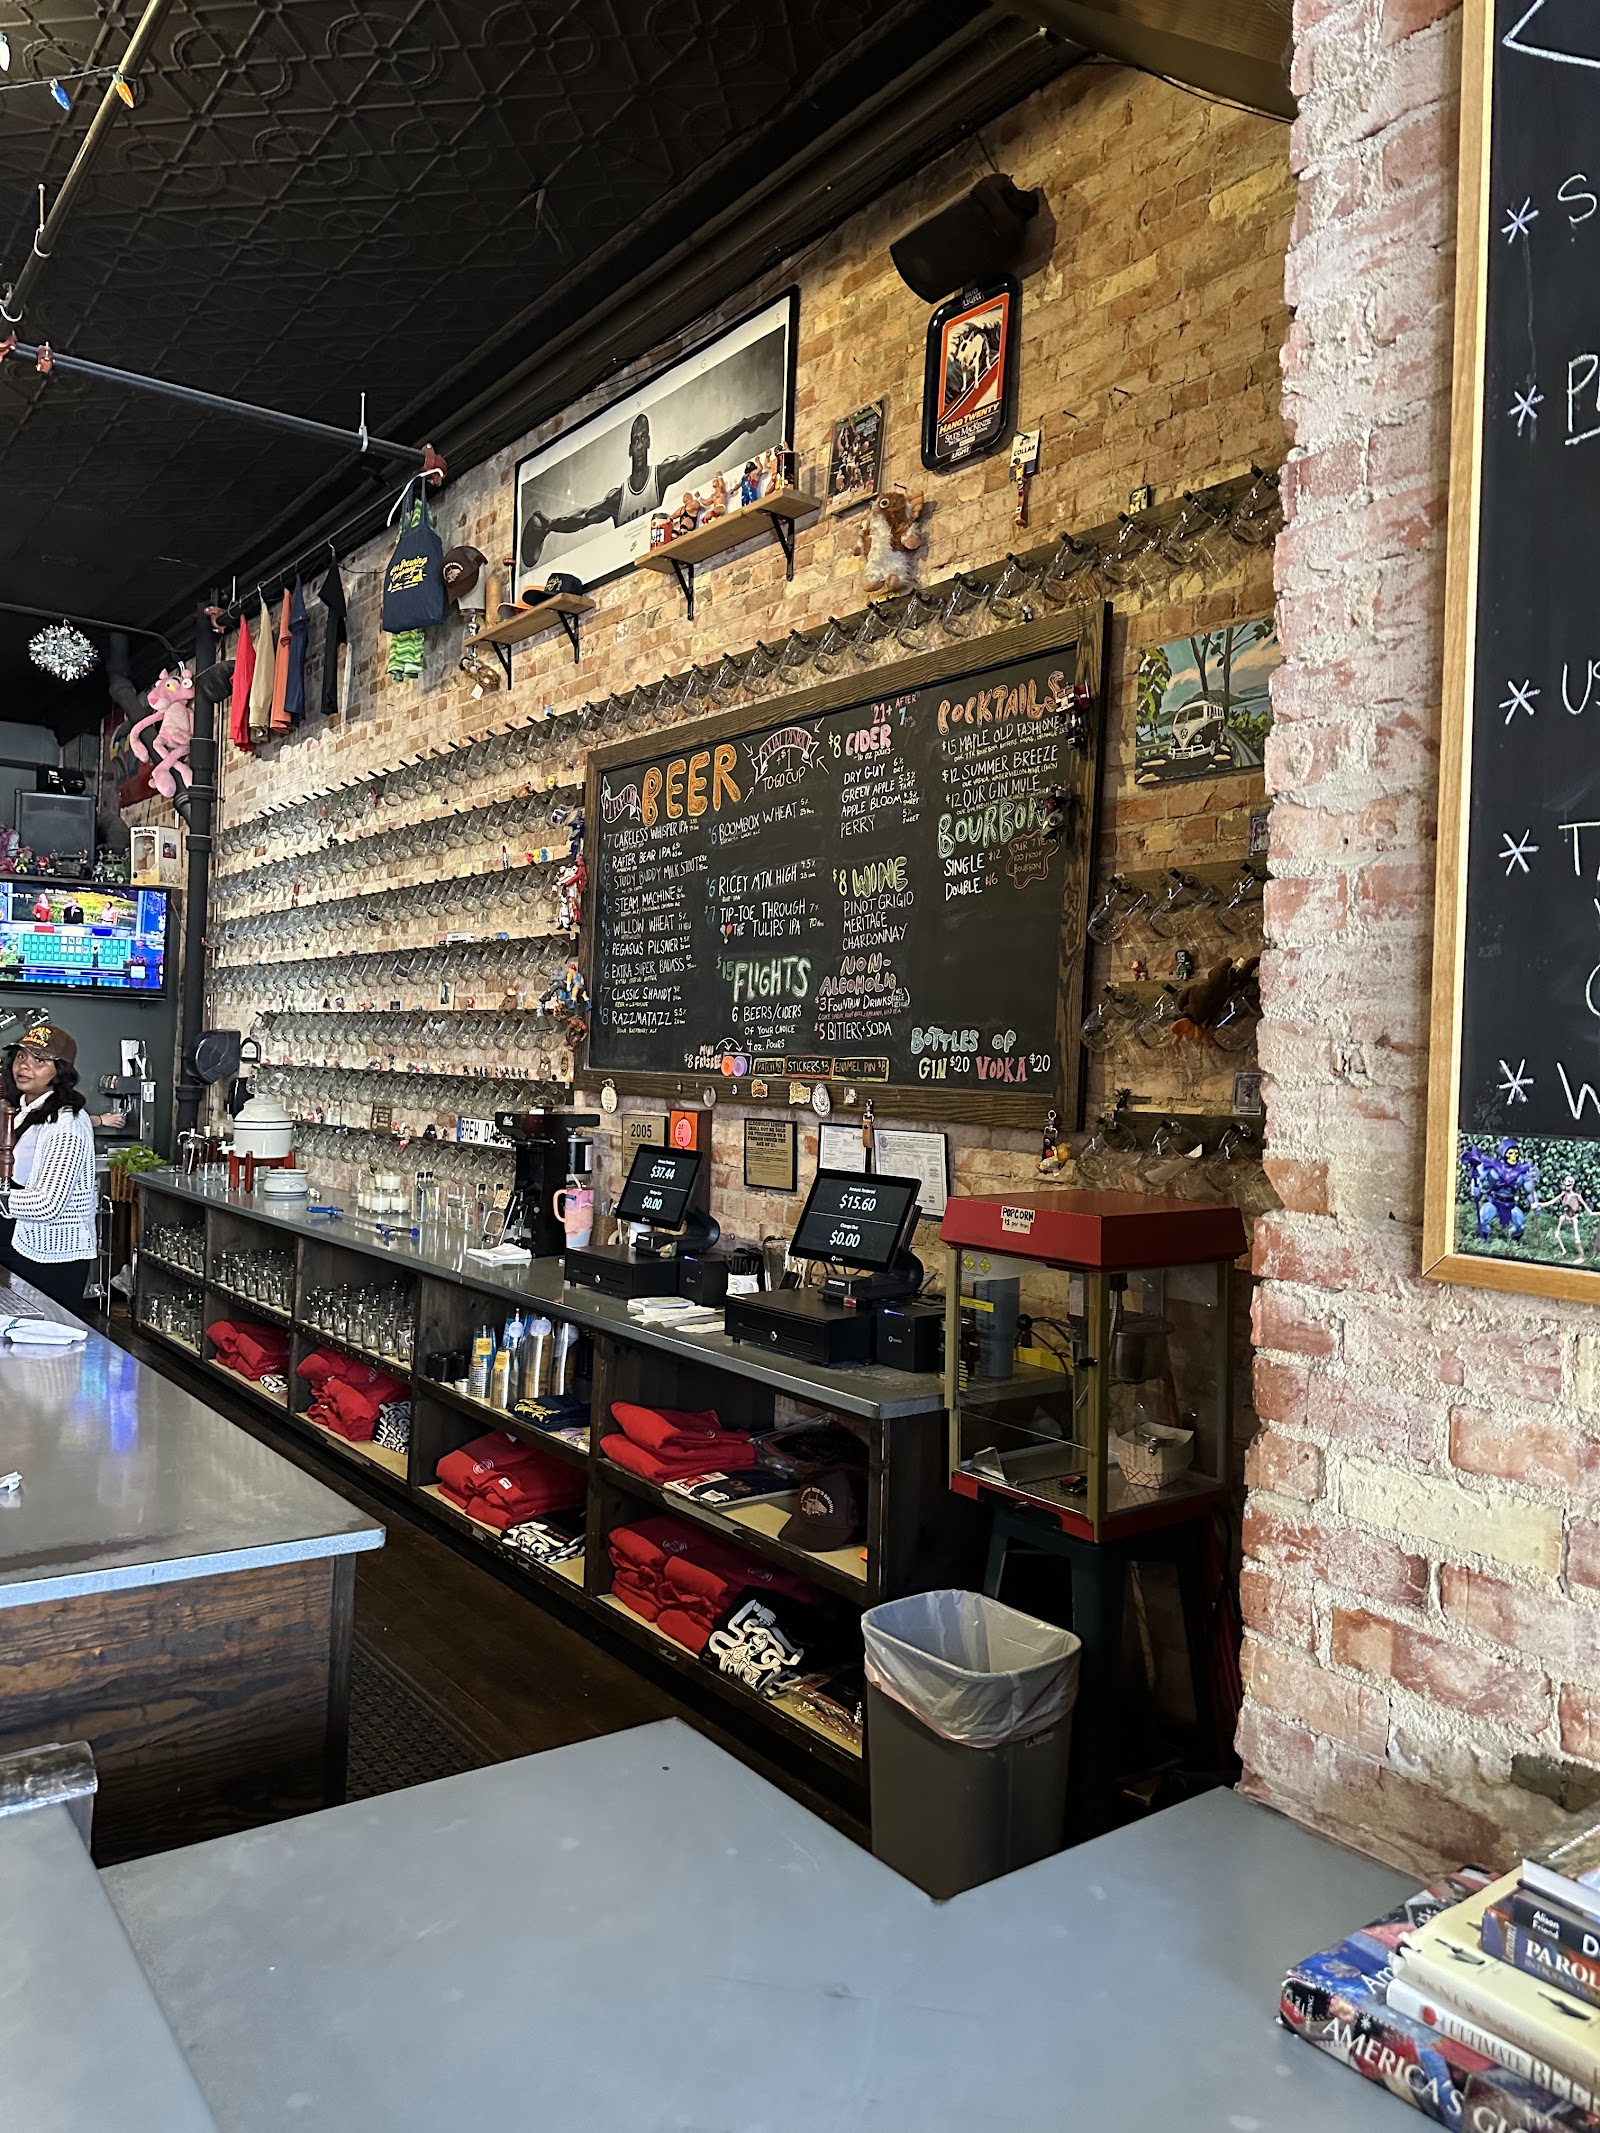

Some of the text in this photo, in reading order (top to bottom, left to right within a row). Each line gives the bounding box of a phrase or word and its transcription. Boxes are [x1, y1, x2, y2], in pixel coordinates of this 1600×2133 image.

[963, 292, 982, 307] LIGHT
[939, 402, 1000, 434] HANG TWENTY
[952, 446, 971, 458] LIGHT
[1013, 445, 1036, 457] COLLAR
[895, 695, 917, 708] AFTER
[937, 671, 1065, 735] COCKTAILS
[828, 731, 841, 758] $8
[846, 724, 892, 756] CIDER
[959, 724, 1013, 754] MAPLE OLD
[786, 766, 806, 784] CUP
[844, 763, 886, 785] DRY GUY
[942, 745, 1058, 784] $12 SUMMER BREEZE
[641, 744, 741, 826] BEER
[841, 771, 916, 803] GREEN APPLE 5.5%
[899, 780, 915, 790] TART
[946, 794, 962, 808] $12
[963, 785, 986, 808] OUR
[989, 781, 1008, 799] GIN
[1011, 774, 1040, 794] MULE
[841, 795, 902, 817] APPLE BLOOM
[708, 824, 718, 844] $6
[718, 813, 760, 842] BOOMBOX
[762, 802, 798, 824] WHEAT
[800, 798, 809, 806] 5%
[841, 814, 875, 838] PERRY
[937, 797, 1048, 858] BOURBON
[603, 832, 611, 849] $7
[614, 826, 649, 849] CARELESS
[650, 821, 678, 841] WHISPER
[679, 820, 689, 834] IPA
[612, 852, 636, 870] RAFTER
[639, 849, 656, 864] BEAR
[658, 846, 671, 860] IPA
[1013, 841, 1028, 853] OUR
[1025, 850, 1042, 861] PROOF
[614, 873, 636, 890] STUDY
[639, 867, 662, 885] BUDDY
[663, 863, 680, 879] MILK
[680, 856, 699, 876] STOUT
[944, 850, 1001, 877] SINGLE $12
[1013, 862, 1042, 874] BOURBON
[706, 864, 798, 898] $6 RICEY HIGH
[833, 856, 908, 897] $8 WINE
[945, 872, 998, 901] DOUBLE $16
[615, 895, 639, 913] STEAM
[642, 886, 676, 907] MACHINE
[704, 898, 819, 923] $7 TIP-TOE THROUGH 7%
[844, 890, 914, 917] PINOT GRIGIO
[613, 912, 687, 937] WILLOW WHEAT 5%
[733, 918, 801, 938] THE TULIPS IPA
[843, 911, 888, 934] MERITAGE
[601, 938, 679, 957] $6 PEGASUS PILSNER
[842, 922, 908, 951] CHARDONNAY
[601, 961, 610, 979] $6
[611, 962, 633, 978] EXTRA
[659, 957, 685, 974] BADASS
[840, 952, 891, 976] NON-
[716, 955, 812, 1003] $15 FLIGHTS
[600, 984, 611, 1002] $7
[611, 987, 640, 1001] CLASSIC
[642, 986, 673, 1002] SHANDY
[814, 996, 826, 1011] $3
[863, 994, 892, 1010] DRINKS
[599, 1004, 609, 1025] $8
[611, 1010, 673, 1026] RAZZMATAZZ
[674, 1008, 687, 1016] 5.5%
[732, 1006, 739, 1022] 6
[775, 1024, 797, 1034] CHOICE
[814, 1020, 892, 1041] $5 BITTERS SODA
[746, 1039, 752, 1052] 4
[911, 1026, 979, 1055] BOTTLES
[684, 1053, 723, 1070] $8 FRISBEE
[757, 1061, 782, 1073] PATCH $8
[788, 1060, 829, 1073] STICKERS $3
[835, 1059, 886, 1073] ENAMEL PIN $8
[918, 1053, 1051, 1083] GIN $20 VODKA $20
[461, 1120, 480, 1141] BREW
[631, 1124, 652, 1139] 2005
[650, 1165, 675, 1180] $37.44
[641, 1195, 662, 1210] $0.00
[839, 1193, 877, 1212] $15.60
[1002, 1207, 1034, 1221] POPCORN
[829, 1229, 860, 1248] $0.00
[1532, 1911, 1560, 1929] Alison
[1532, 1919, 1560, 1940] Friend
[1449, 2020, 1527, 2074] ULTIMATE
[1322, 2017, 1466, 2116] AMERICA'S
